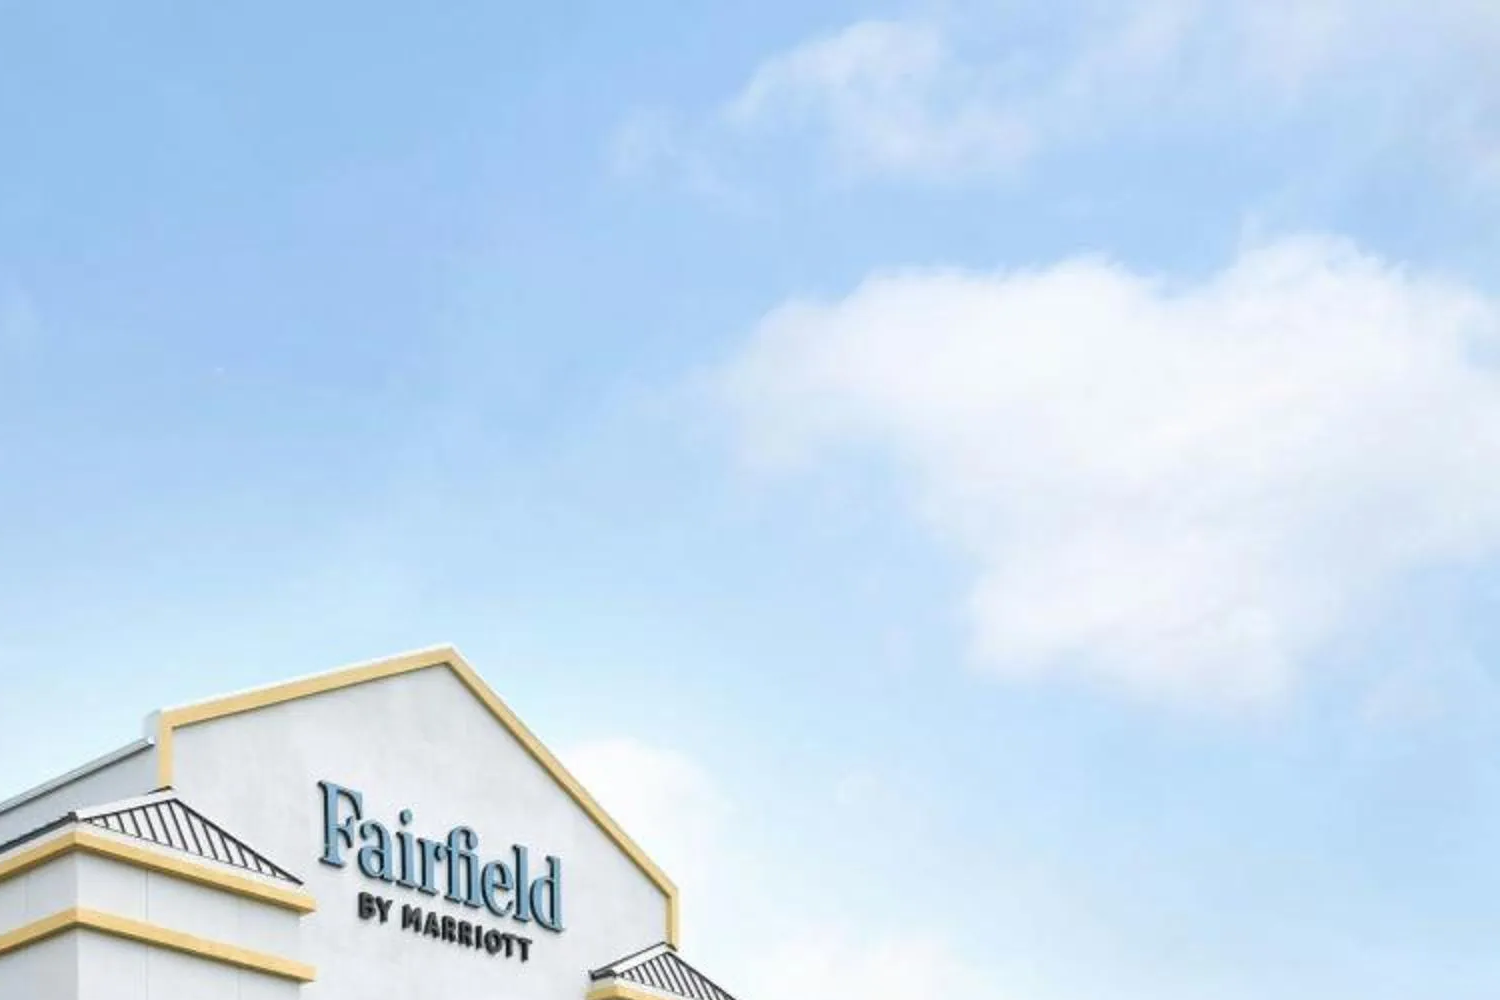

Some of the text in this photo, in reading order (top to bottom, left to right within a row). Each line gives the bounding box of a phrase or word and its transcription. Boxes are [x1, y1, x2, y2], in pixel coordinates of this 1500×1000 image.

[316, 779, 565, 934] Fairfield
[357, 891, 533, 963] BY MARRIOTT
